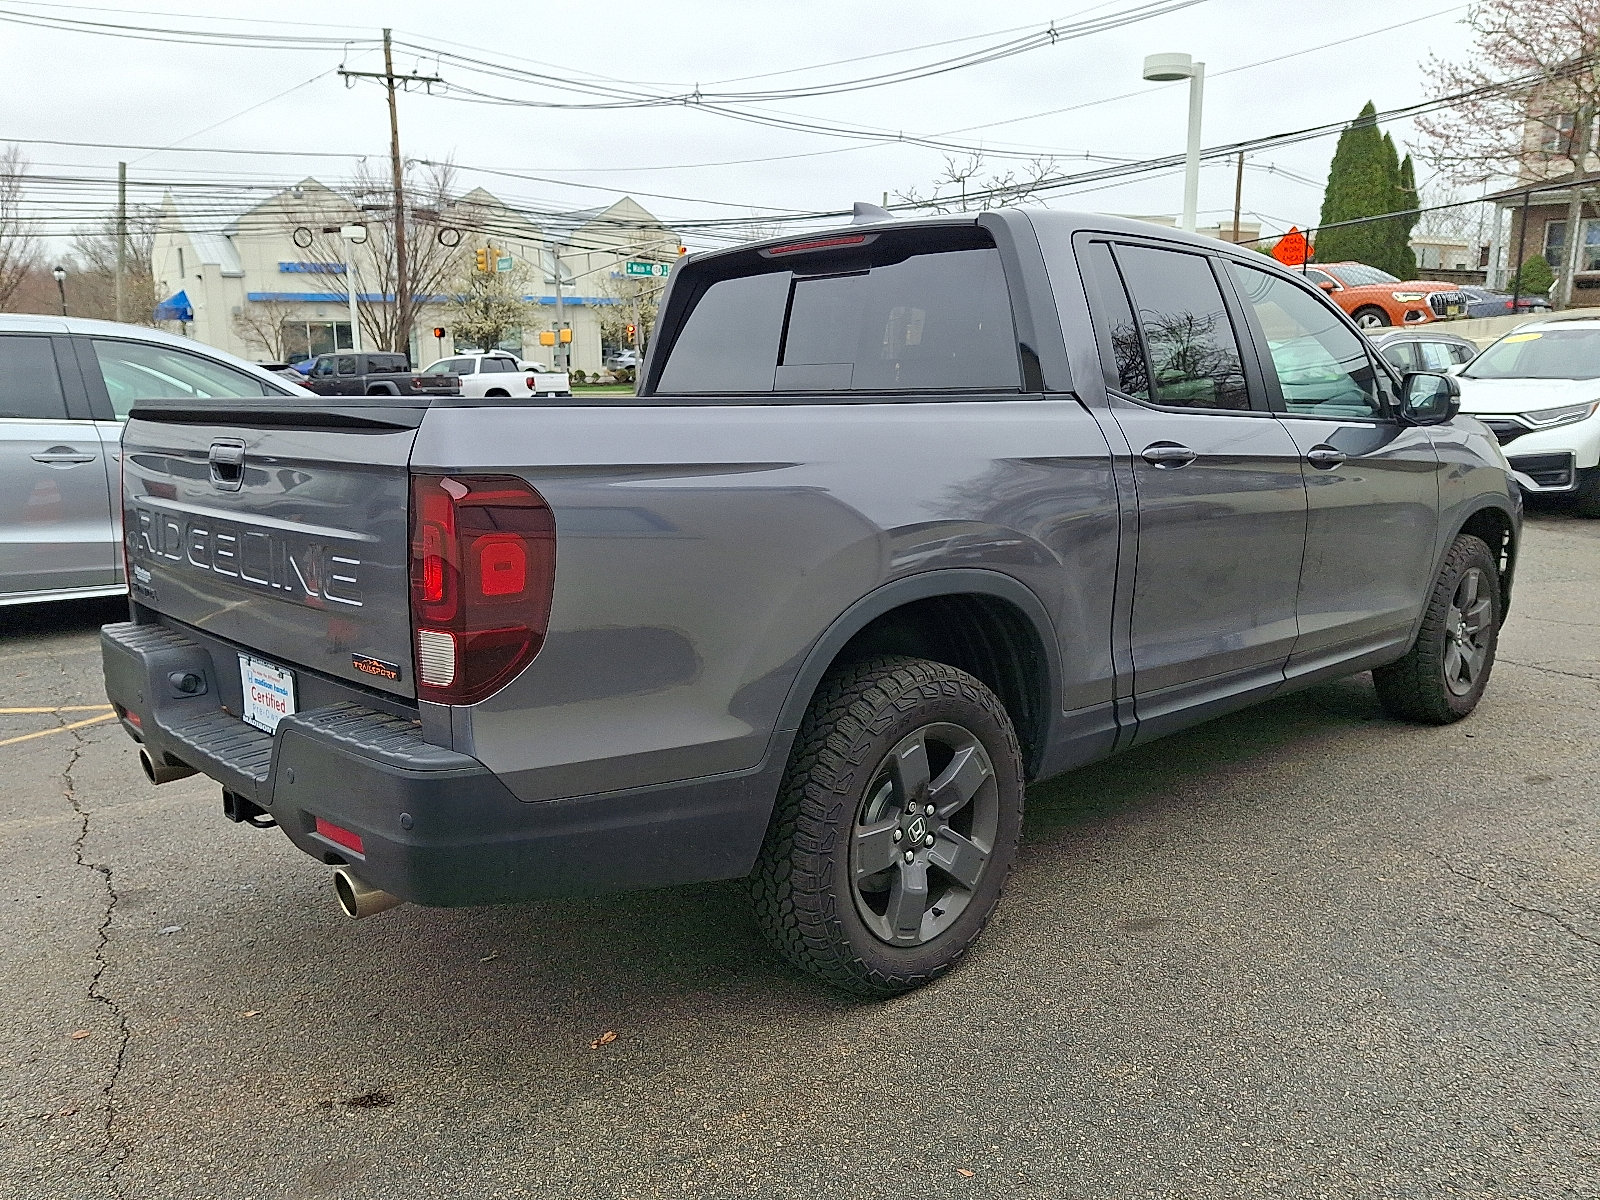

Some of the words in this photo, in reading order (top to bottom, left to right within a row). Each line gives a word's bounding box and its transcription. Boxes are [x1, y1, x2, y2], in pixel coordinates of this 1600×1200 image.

[632, 264, 645, 272] Main
[137, 507, 363, 607] RIDGELINE
[352, 661, 397, 680] TRAILSPORT
[251, 686, 286, 714] Certified
